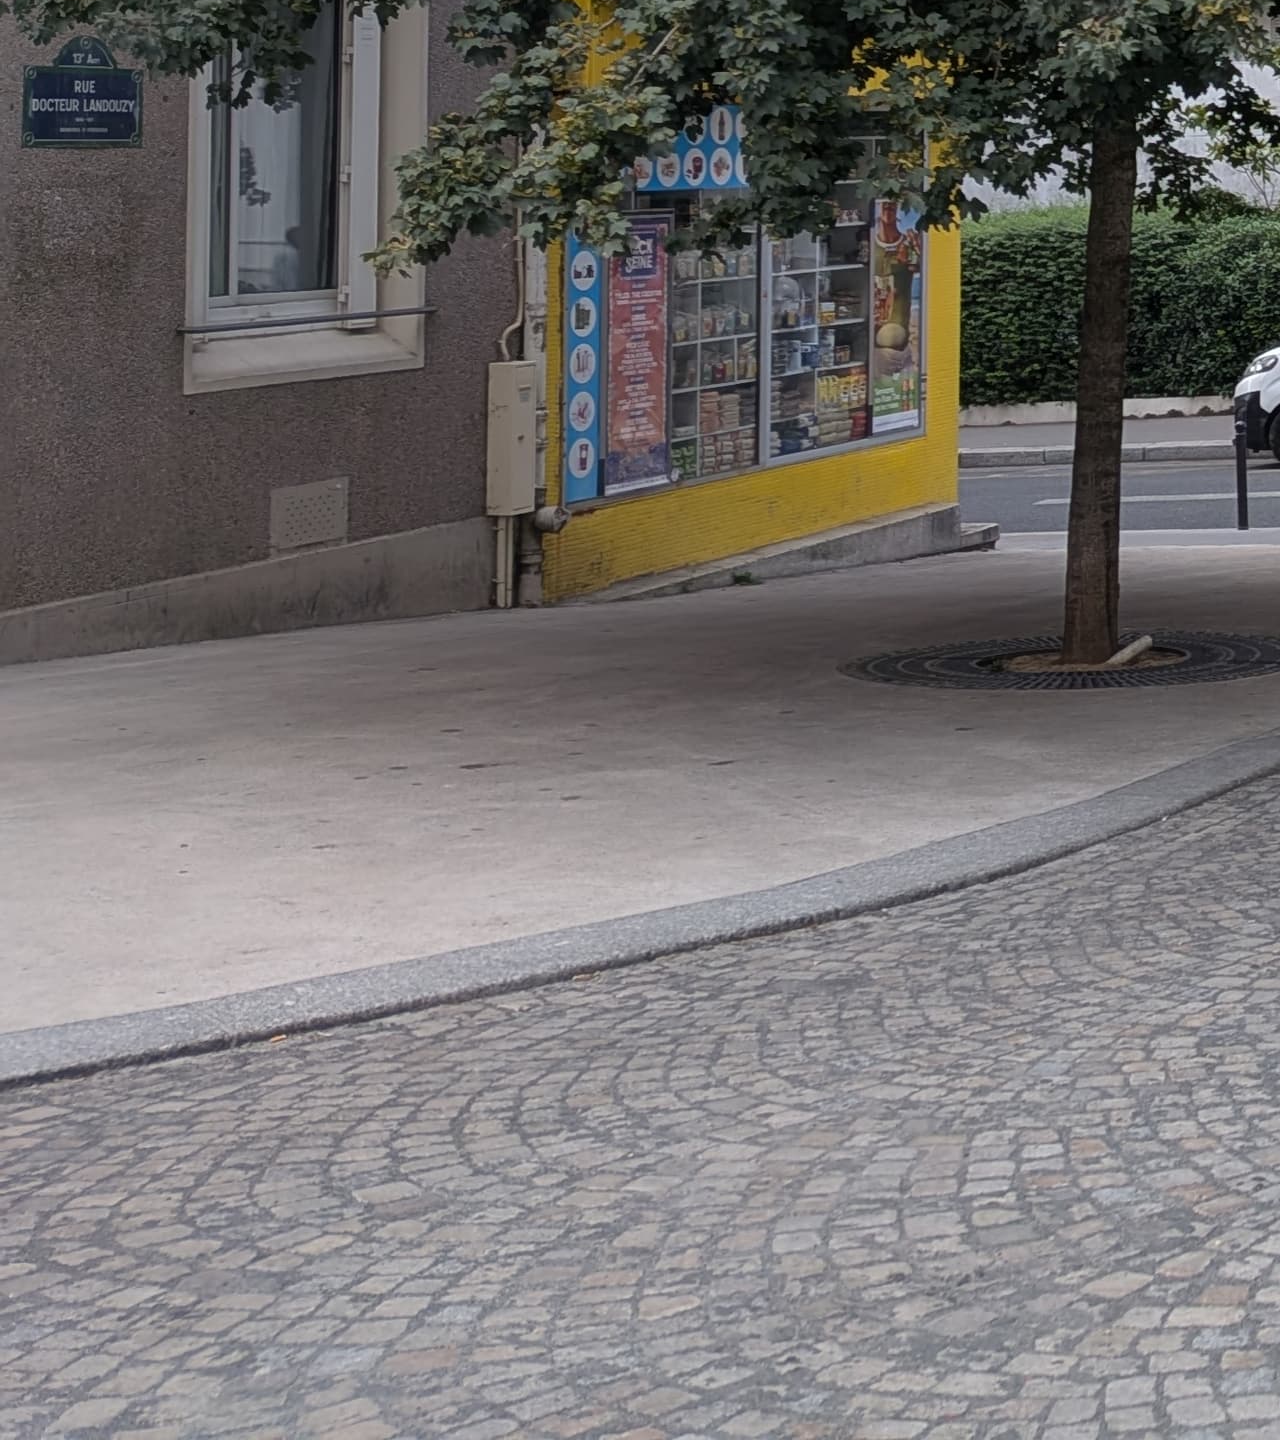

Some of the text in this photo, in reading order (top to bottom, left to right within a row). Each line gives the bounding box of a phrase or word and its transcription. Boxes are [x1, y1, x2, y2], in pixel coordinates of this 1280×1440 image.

[74, 80, 96, 94] RUE
[31, 98, 135, 113] DOCTEUR LANDOUZY
